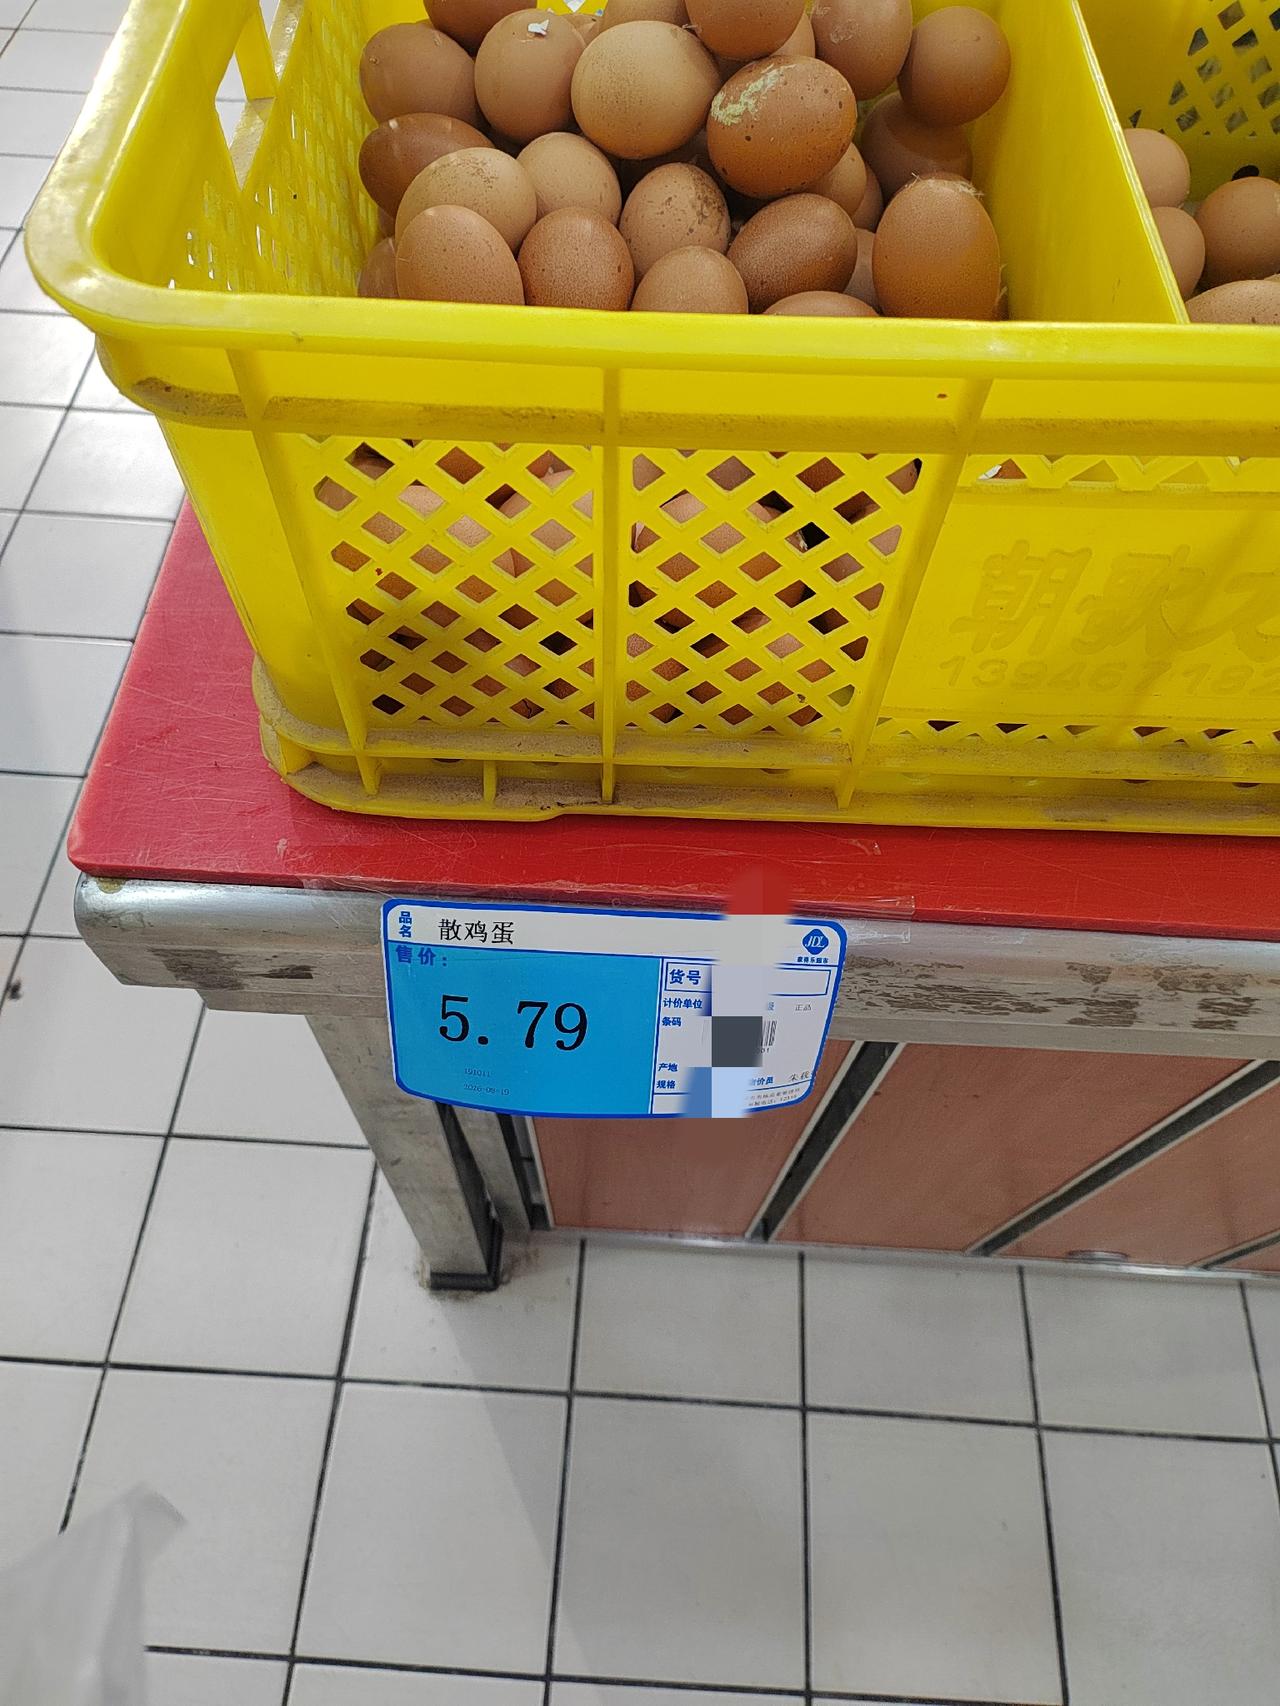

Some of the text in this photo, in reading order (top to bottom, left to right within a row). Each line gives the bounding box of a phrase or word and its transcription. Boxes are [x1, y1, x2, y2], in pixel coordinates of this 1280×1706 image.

[399, 911, 412, 938] 品名
[438, 919, 514, 945] 散鸡蛋
[669, 968, 702, 985] 货号
[663, 998, 703, 1010] 计价单位
[661, 1016, 682, 1027] 条码
[658, 1062, 679, 1073] 产地
[656, 1080, 676, 1090] 规格
